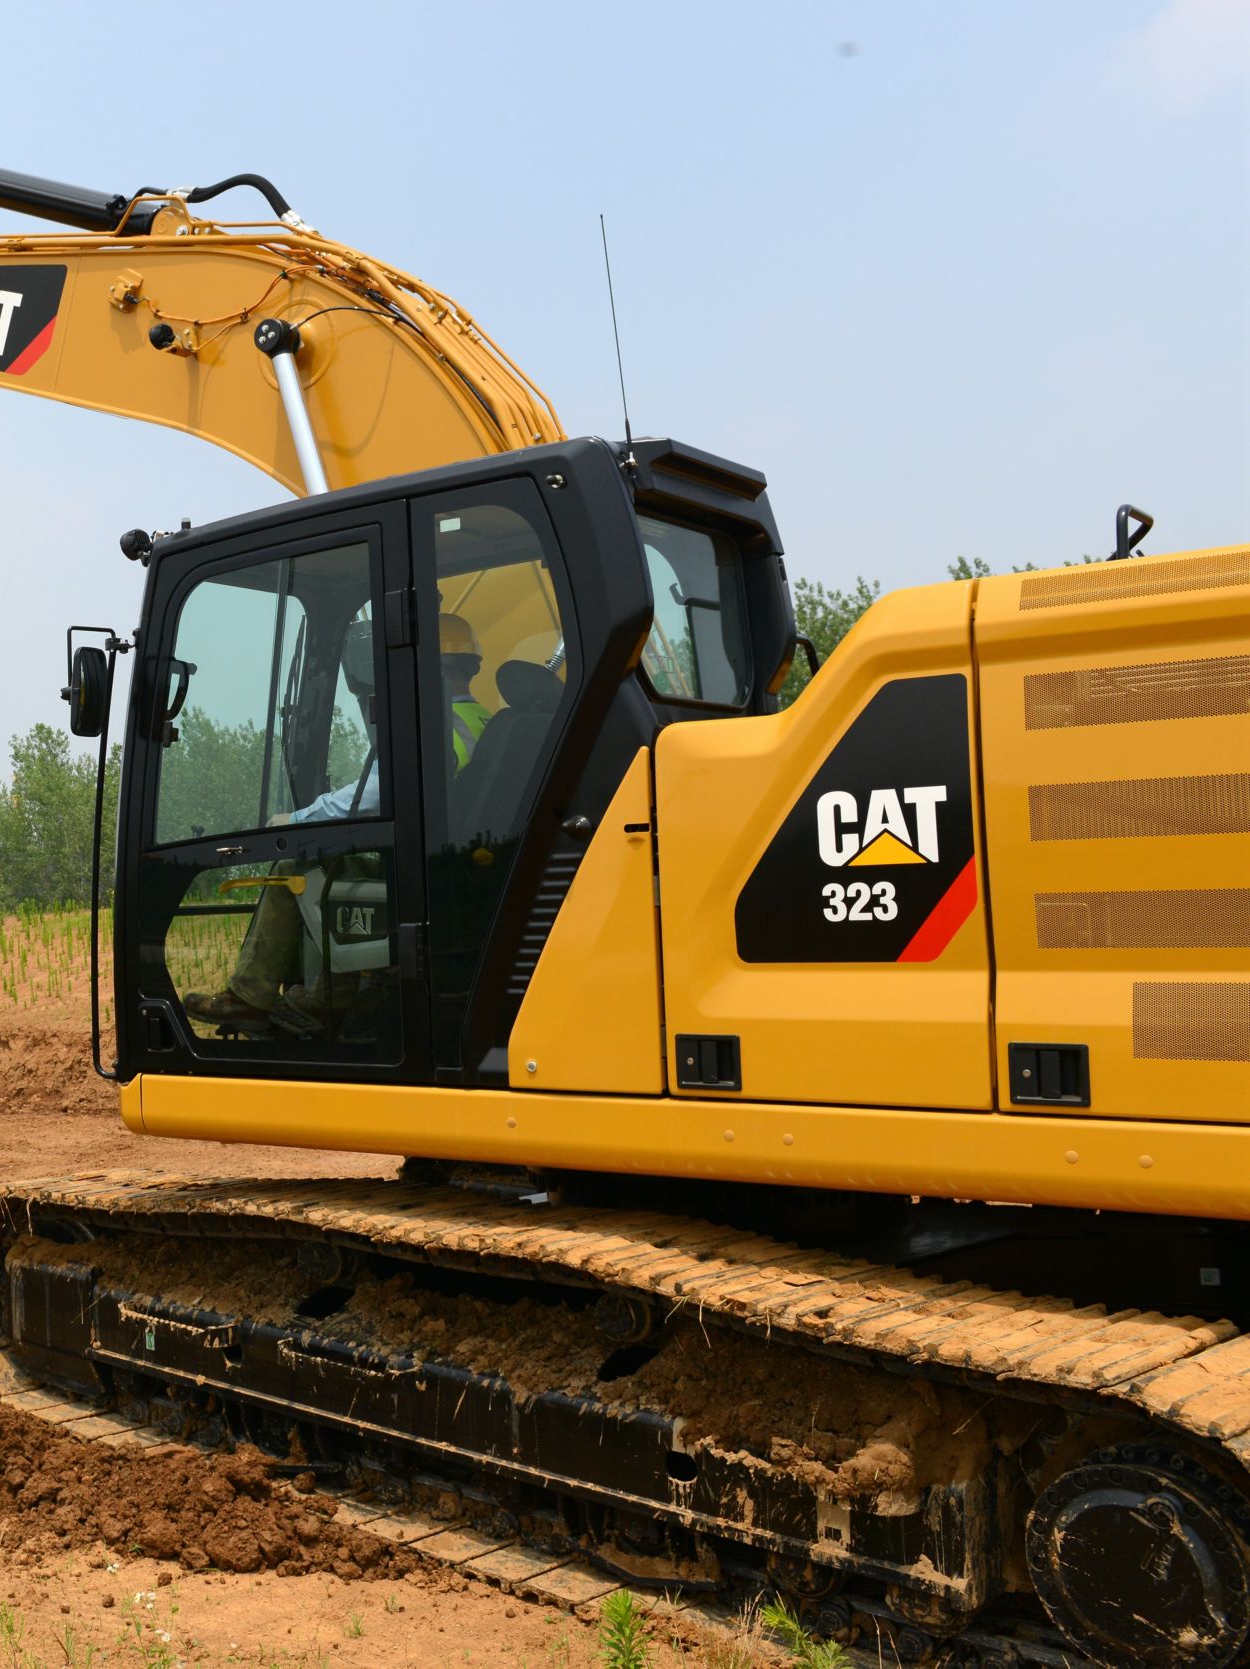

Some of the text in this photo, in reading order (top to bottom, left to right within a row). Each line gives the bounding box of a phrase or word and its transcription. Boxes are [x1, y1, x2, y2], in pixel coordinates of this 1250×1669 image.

[817, 785, 947, 867] CAT
[337, 906, 375, 935] CAT
[822, 881, 898, 922] 323
